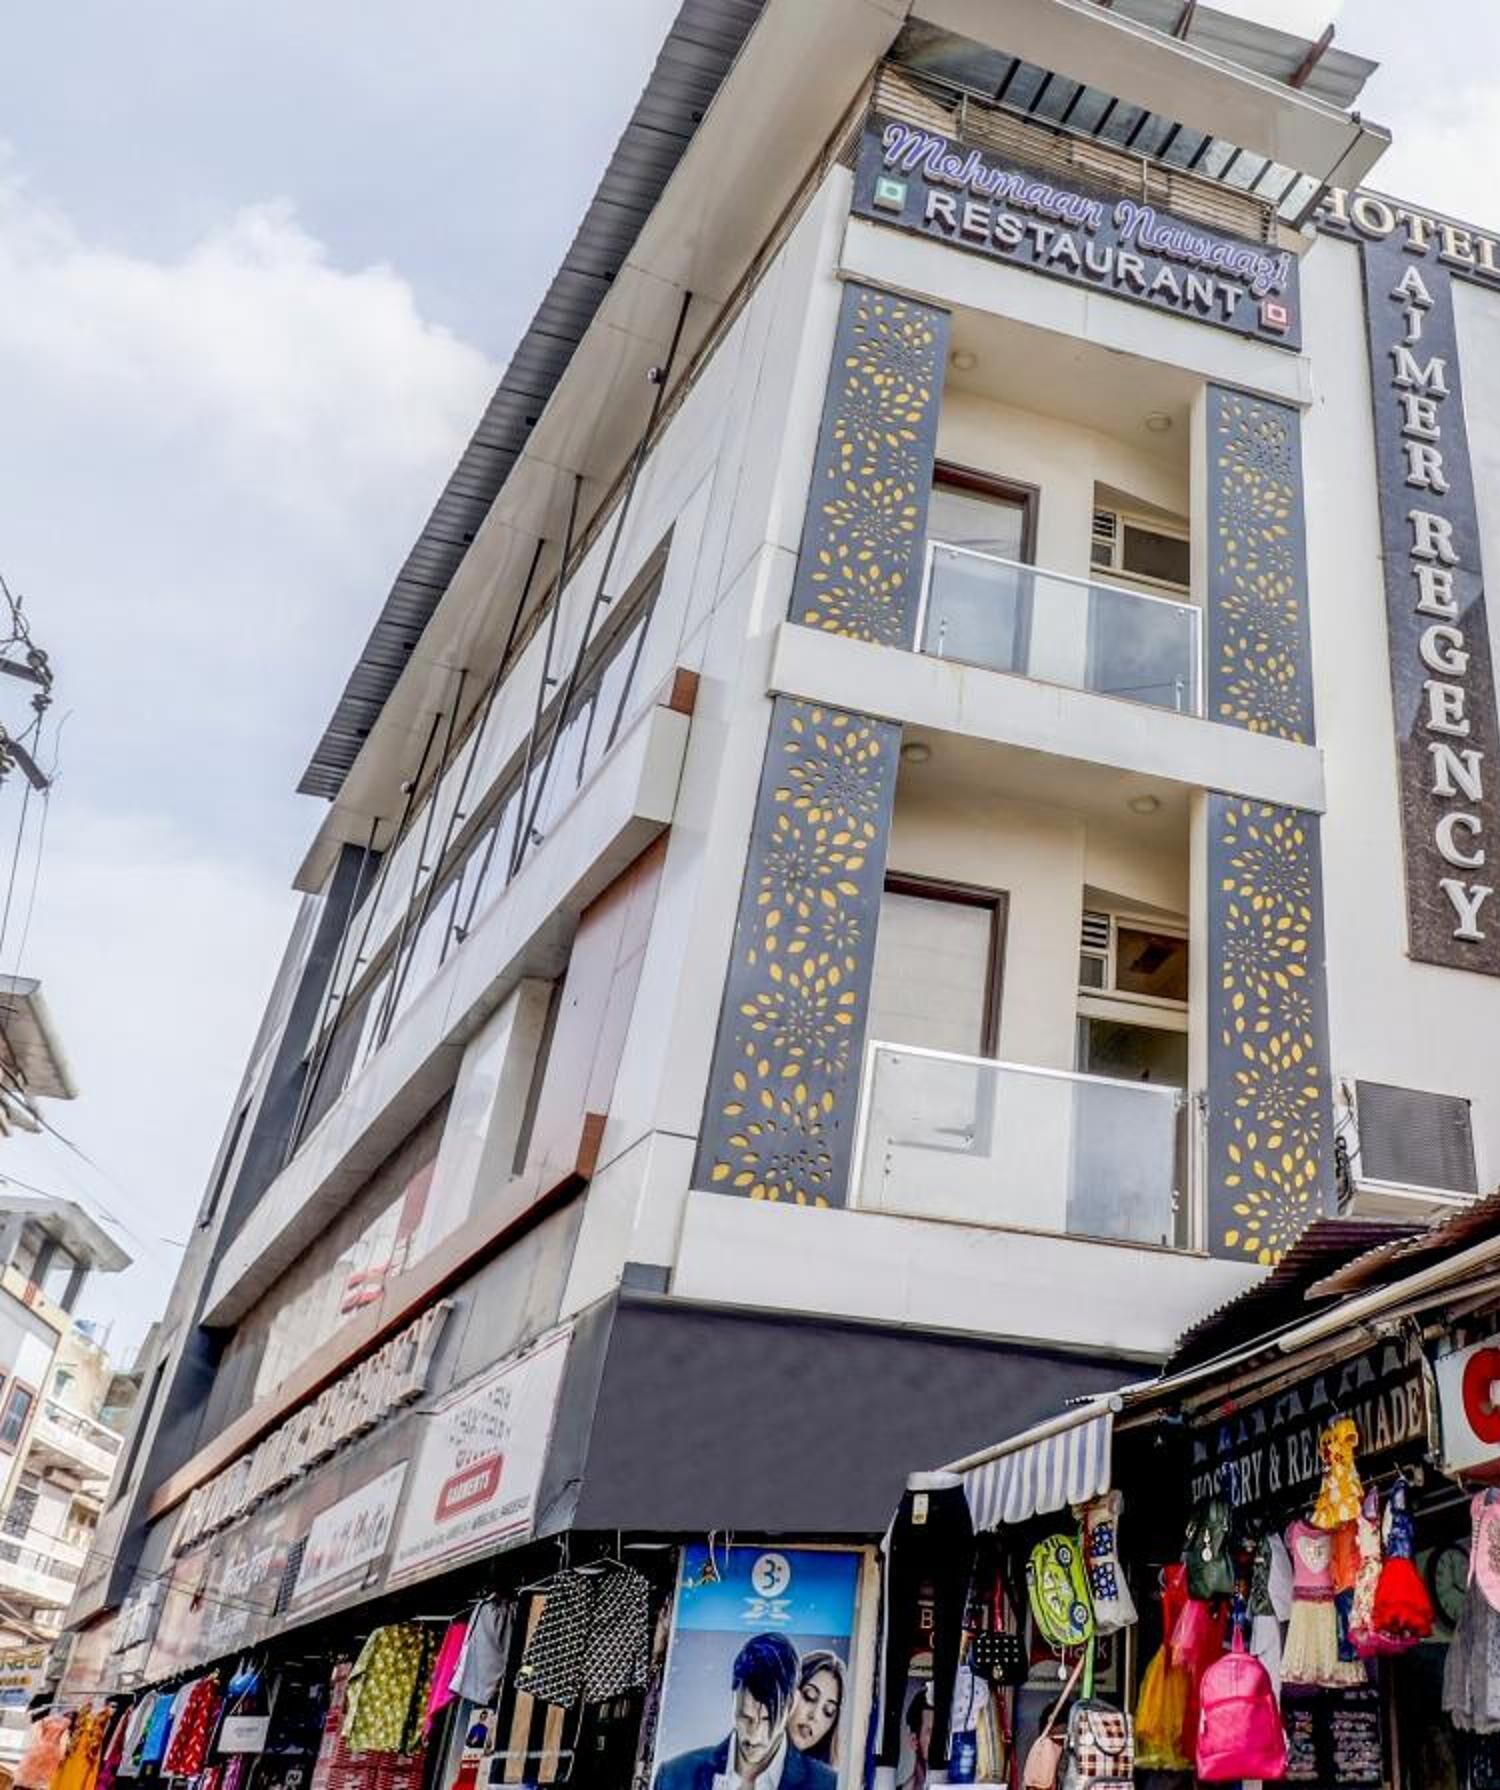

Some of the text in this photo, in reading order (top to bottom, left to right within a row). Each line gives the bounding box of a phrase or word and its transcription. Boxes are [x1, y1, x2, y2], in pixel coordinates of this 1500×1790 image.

[882, 122, 1289, 296] Mehmaan Nawaazi
[924, 189, 1242, 318] RESTAURANT
[1391, 264, 1494, 942] AJMER REGENCY
[1268, 1444, 1281, 1493] &
